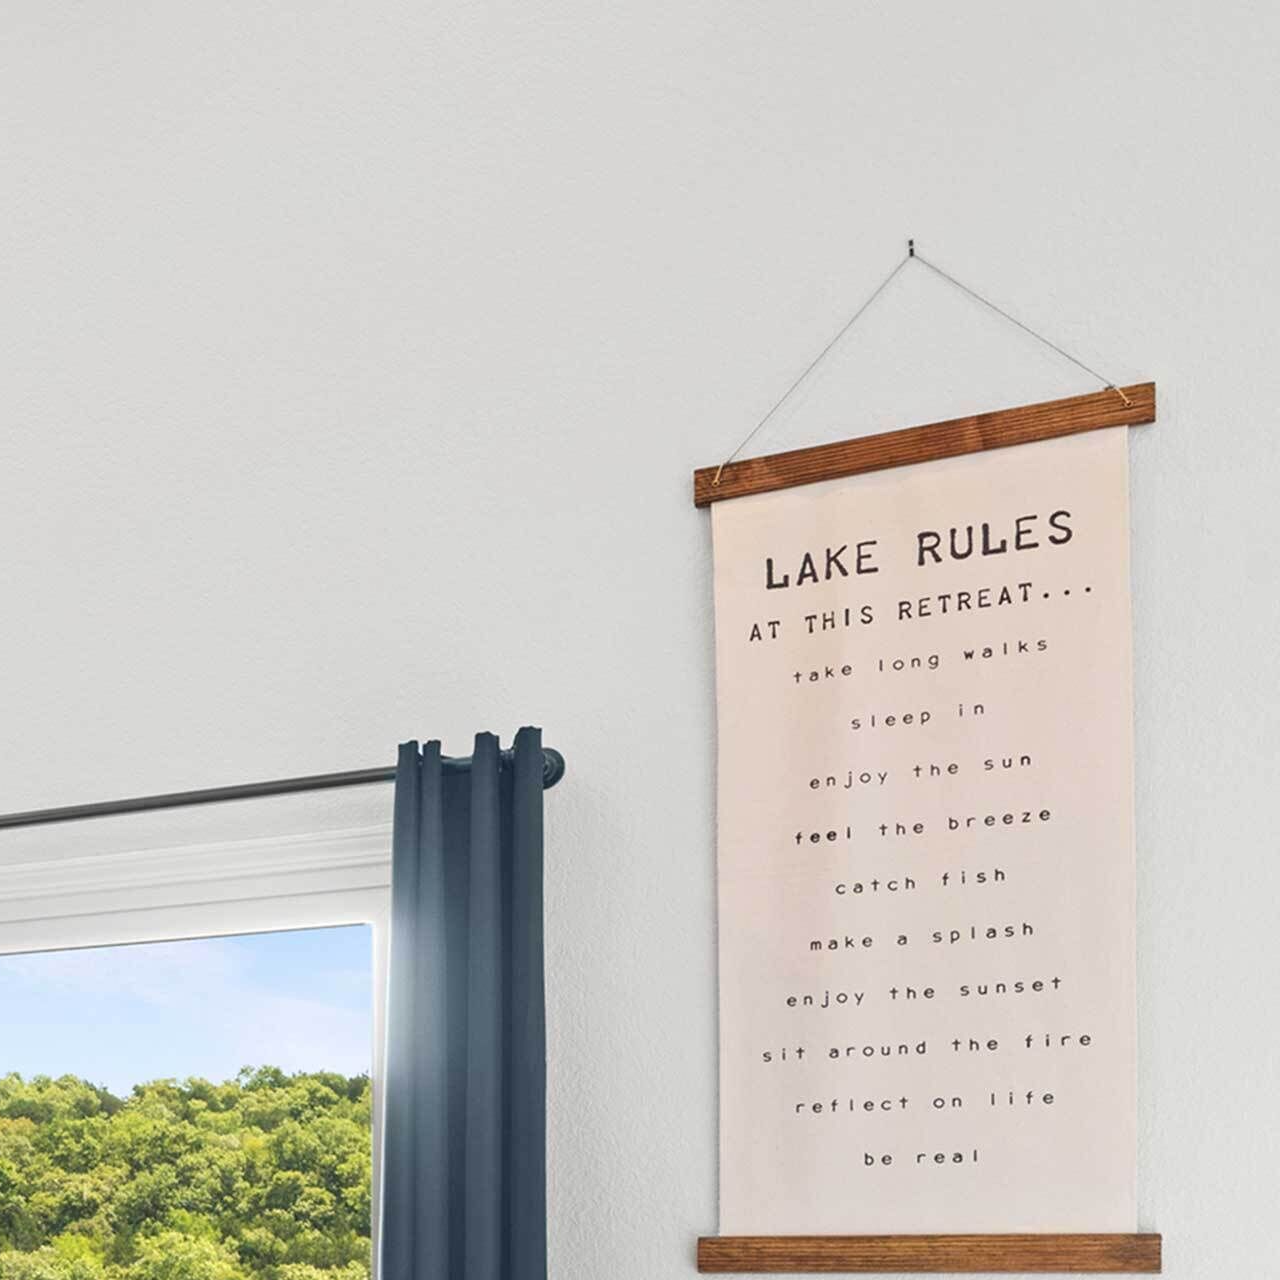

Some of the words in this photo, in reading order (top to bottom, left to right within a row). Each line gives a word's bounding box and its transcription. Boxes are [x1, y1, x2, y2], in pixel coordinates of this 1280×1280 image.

[765, 540, 879, 590] LAKE
[917, 511, 1073, 567] RULES
[749, 620, 781, 642] AT
[805, 606, 874, 634] THIS
[898, 582, 1093, 621] RETREAT...
[793, 664, 852, 684] take
[879, 653, 939, 672] long
[963, 639, 1048, 661] walks
[851, 710, 931, 730] sleep
[959, 703, 985, 718] in
[809, 773, 888, 790] enjoy
[913, 763, 959, 779] the
[984, 754, 1032, 772] sun
[795, 826, 851, 845] feel
[879, 822, 924, 837] the
[948, 809, 1051, 831] breeze
[835, 877, 916, 895] catch
[942, 868, 1006, 886] fish
[810, 935, 873, 951] make
[896, 934, 908, 946] a
[932, 922, 1035, 945] splash
[786, 990, 865, 1009] enjoy
[889, 987, 936, 1000] the
[960, 976, 1062, 997] sunset
[762, 1047, 805, 1063] sit
[828, 1041, 927, 1060] around
[951, 1038, 999, 1052] the
[1025, 1034, 1092, 1049] fire
[795, 1096, 909, 1114] reflect
[932, 1096, 963, 1109] on
[991, 1091, 1055, 1106] life
[864, 1152, 893, 1166] be
[916, 1150, 979, 1164] real
